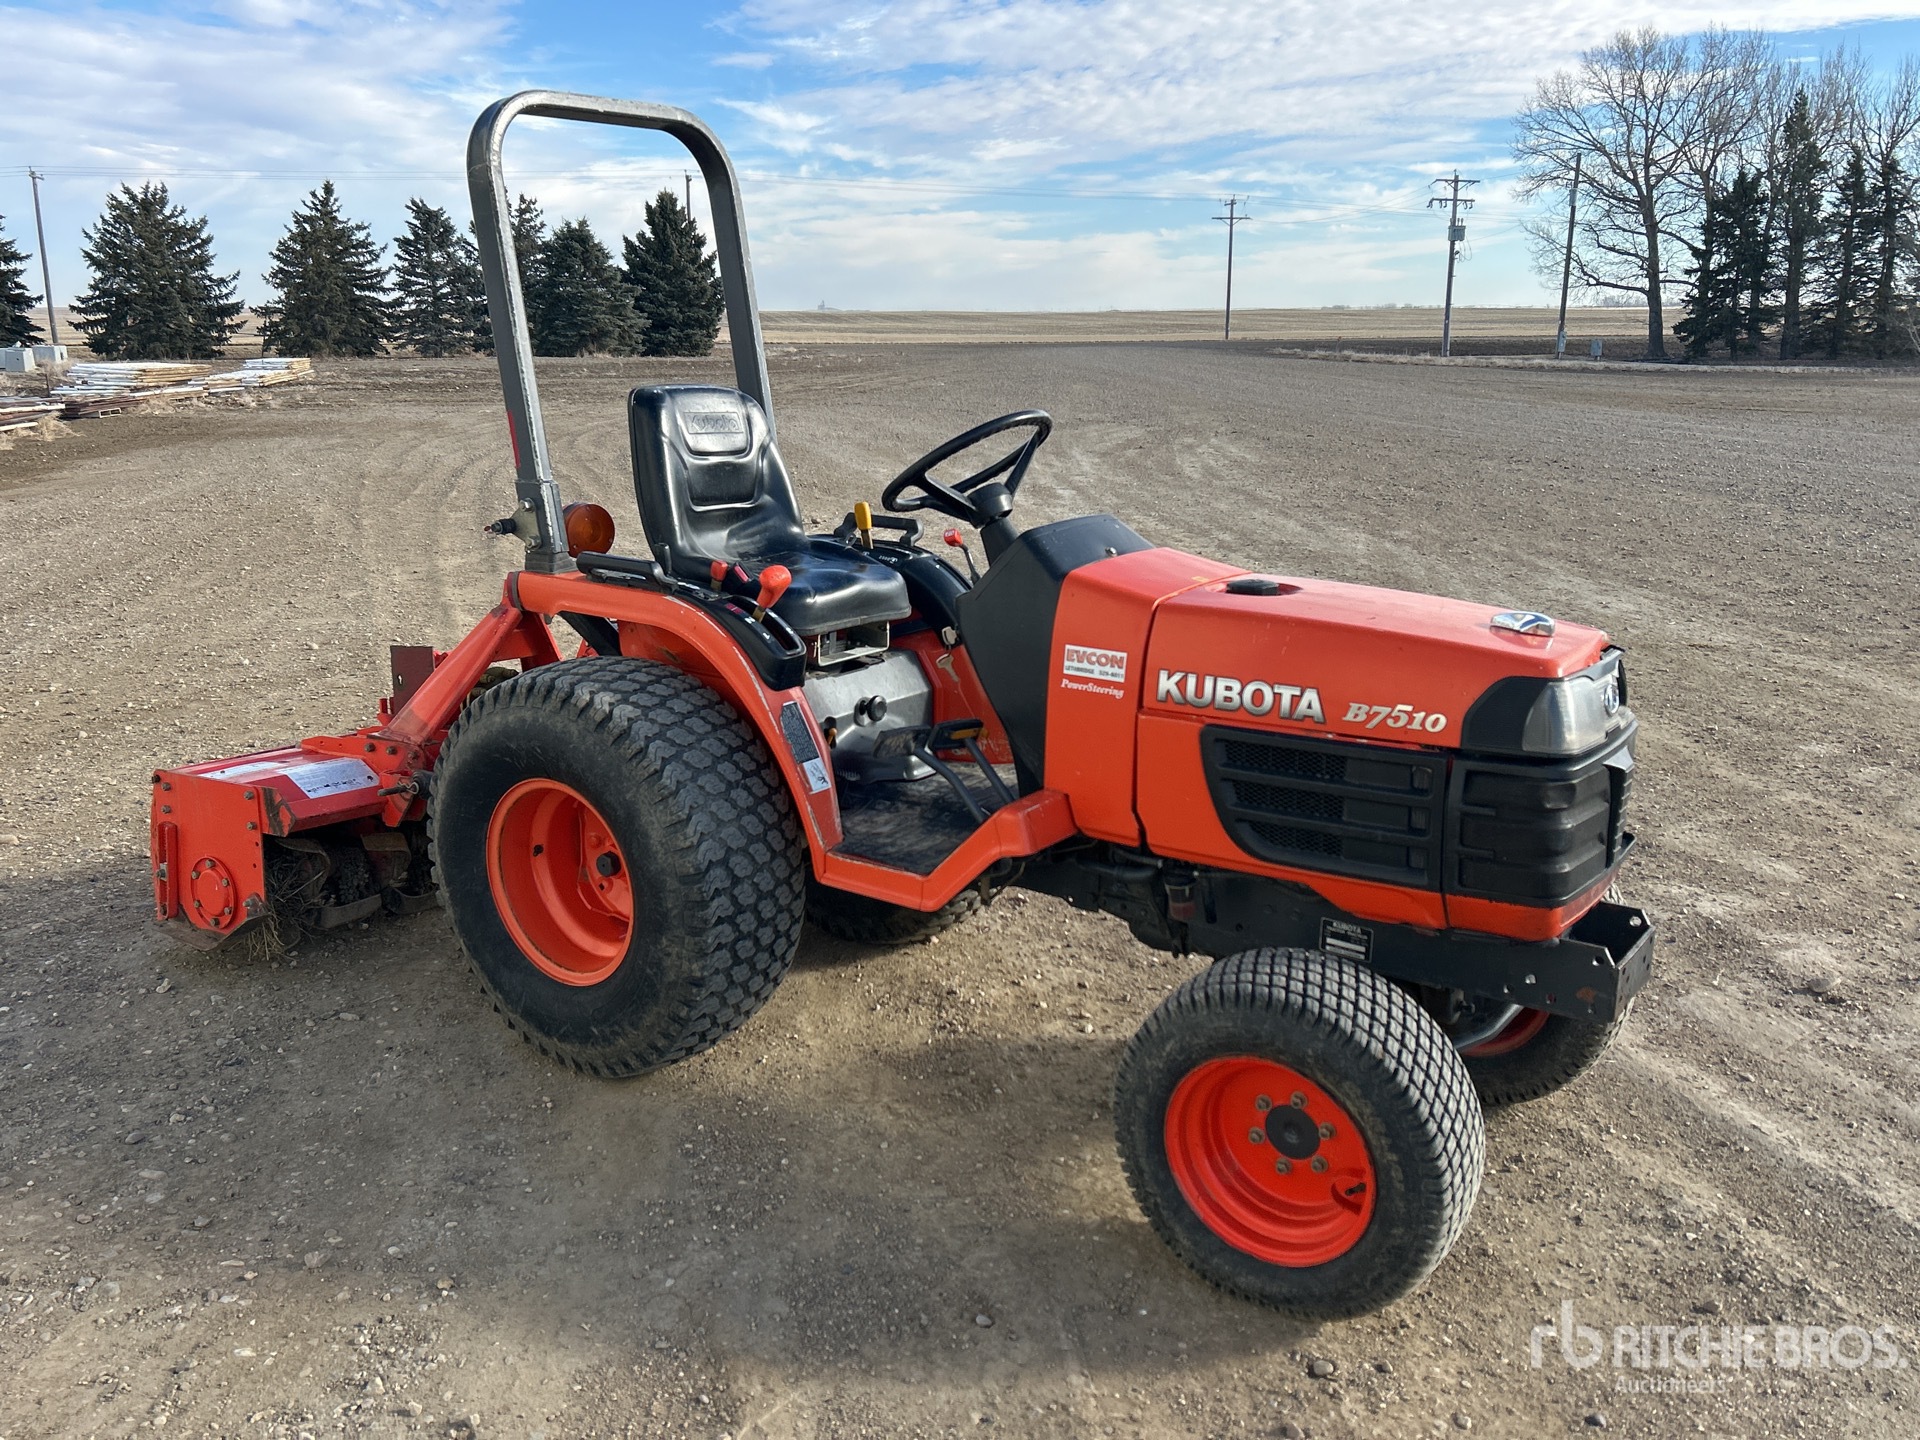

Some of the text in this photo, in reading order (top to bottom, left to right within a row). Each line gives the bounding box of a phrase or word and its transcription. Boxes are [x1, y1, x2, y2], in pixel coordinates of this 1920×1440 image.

[1066, 648, 1125, 669] EVCON
[1060, 678, 1125, 699] PowerSteering
[1156, 669, 1327, 724] KUBOTA
[1341, 702, 1448, 733] B7510
